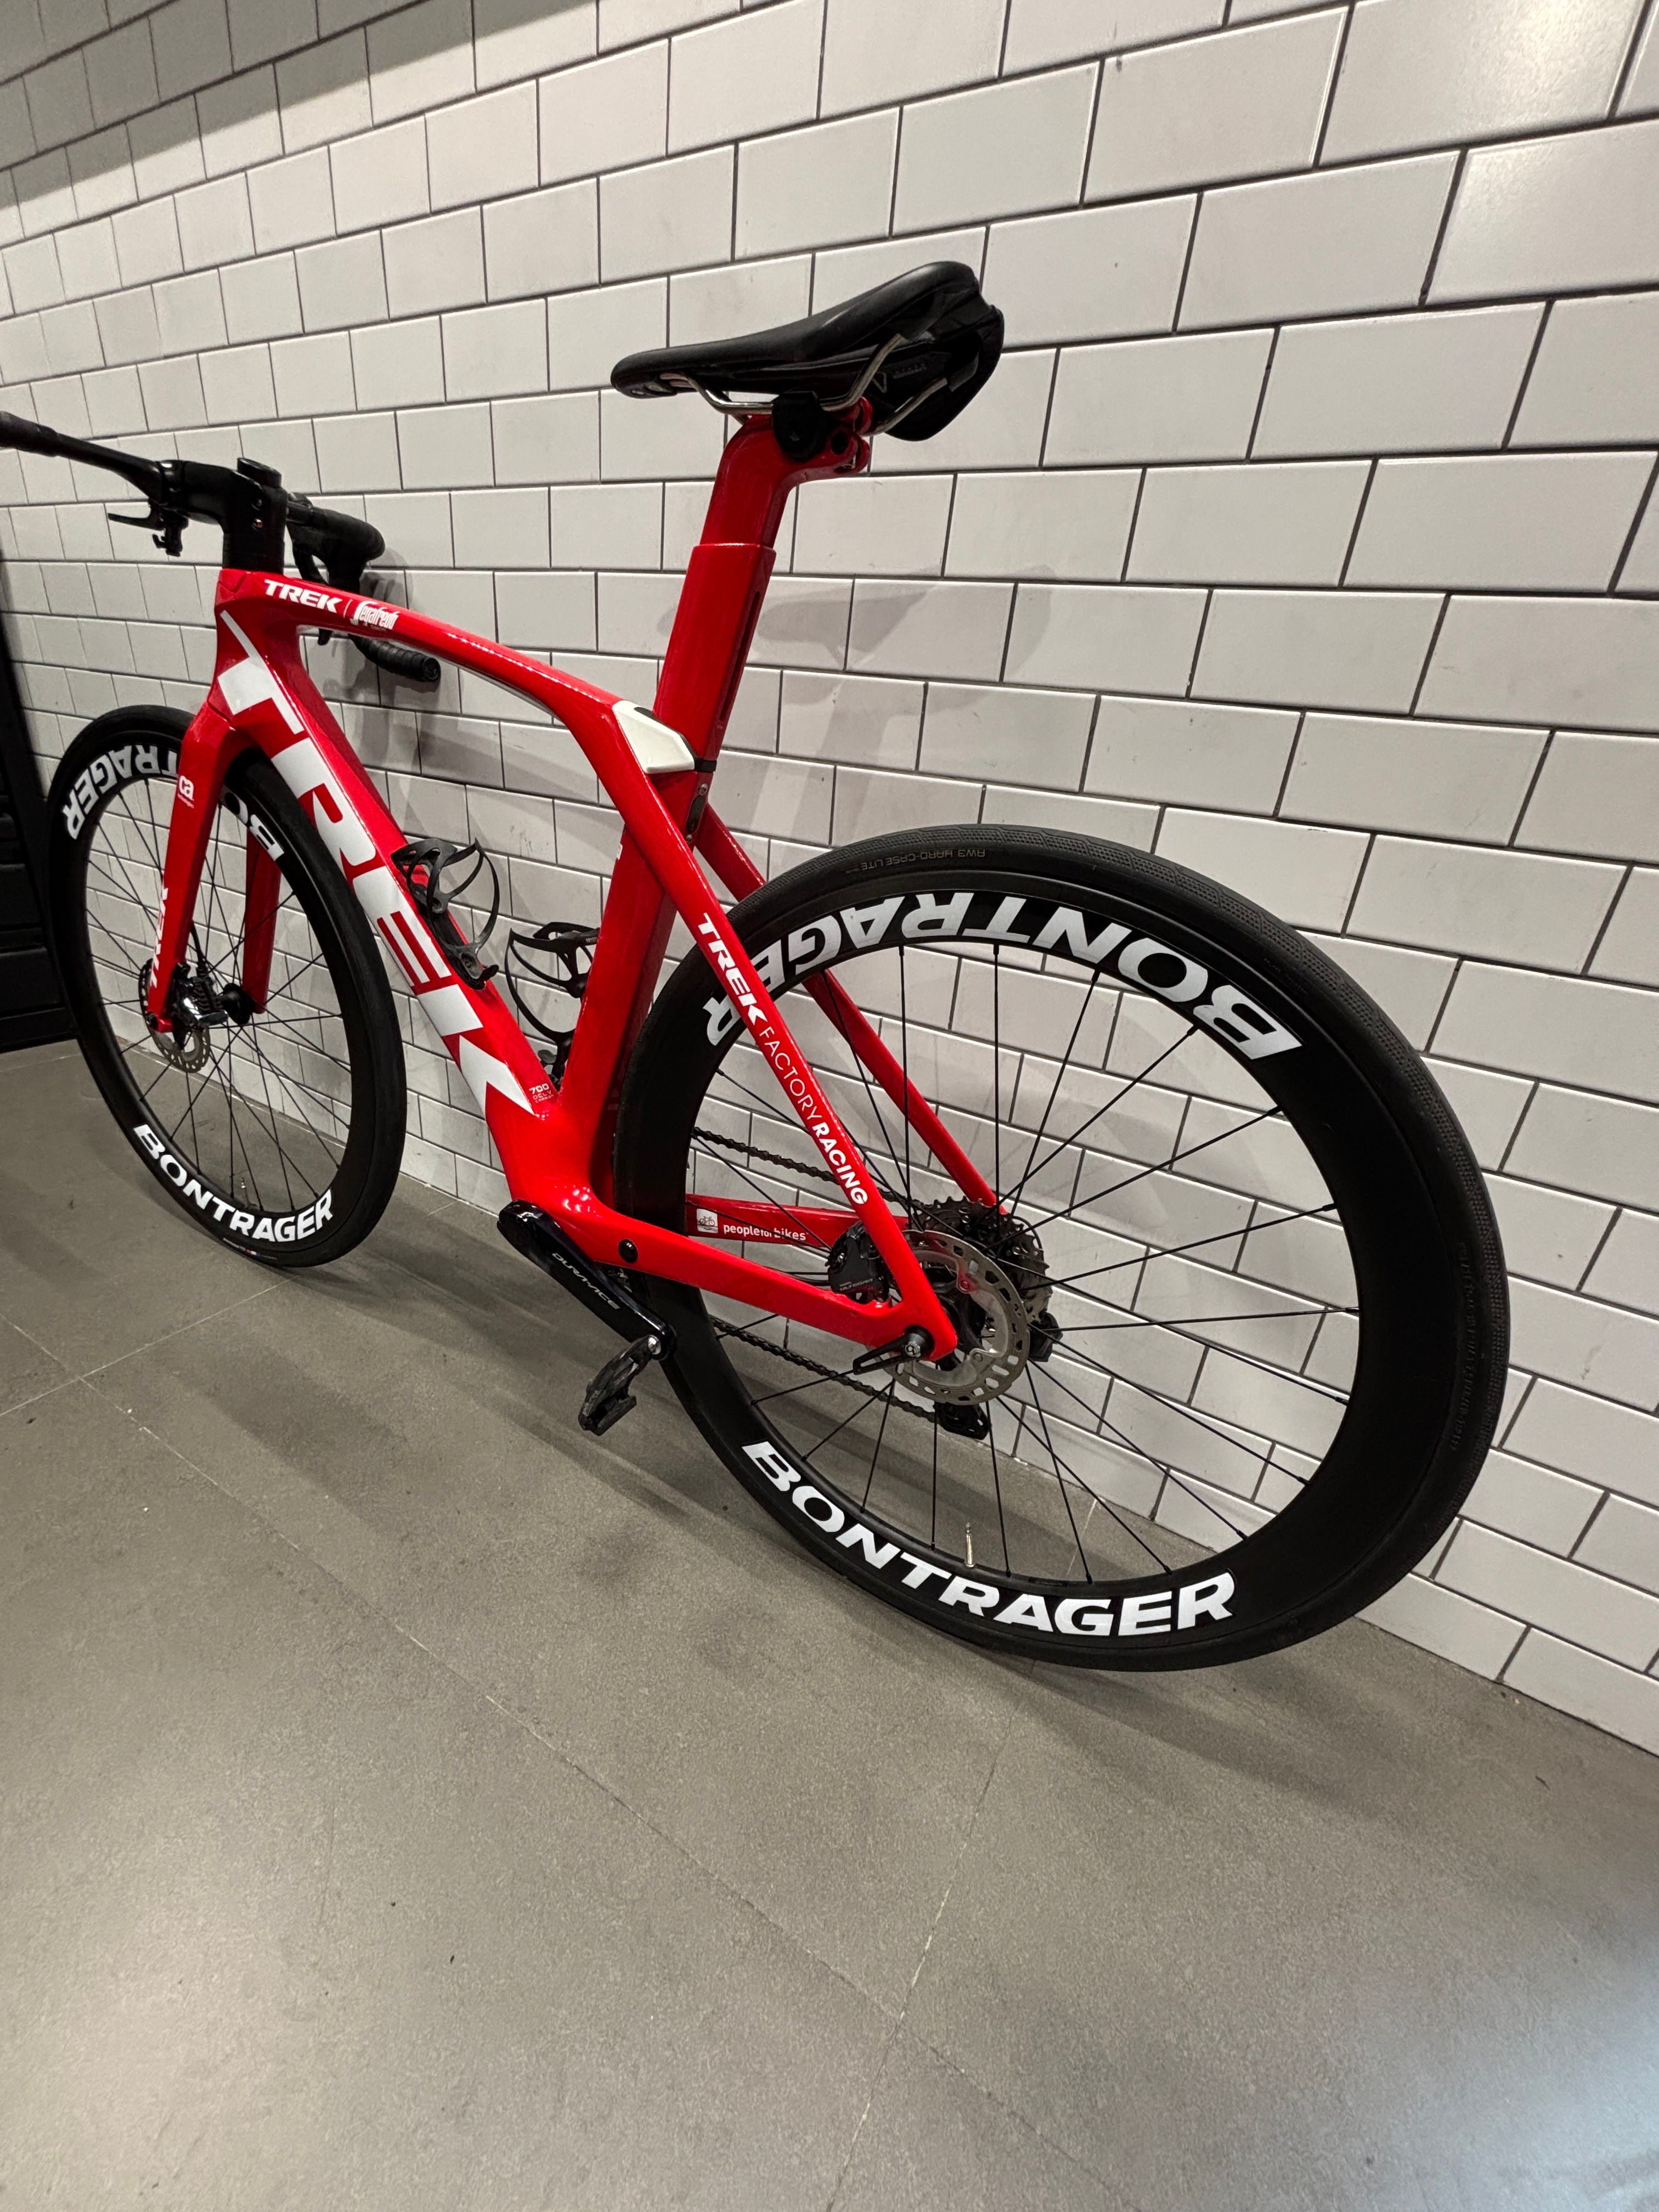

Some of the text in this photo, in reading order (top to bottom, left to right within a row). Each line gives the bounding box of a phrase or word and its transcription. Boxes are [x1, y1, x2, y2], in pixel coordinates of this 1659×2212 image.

[264, 579, 343, 613] TREK
[219, 610, 535, 1116] TREK
[861, 860, 884, 871] LITE
[887, 851, 953, 866] HARD-CASE
[957, 849, 986, 857] AW3
[703, 893, 1302, 1059] BONTRAGER
[698, 913, 868, 1205] TREK FACTORY RACING
[528, 1083, 549, 1095] 700
[532, 1090, 551, 1100] OCLV
[133, 1124, 332, 1242] BONTRAGER
[742, 1441, 1236, 1637] BONTRAGER
